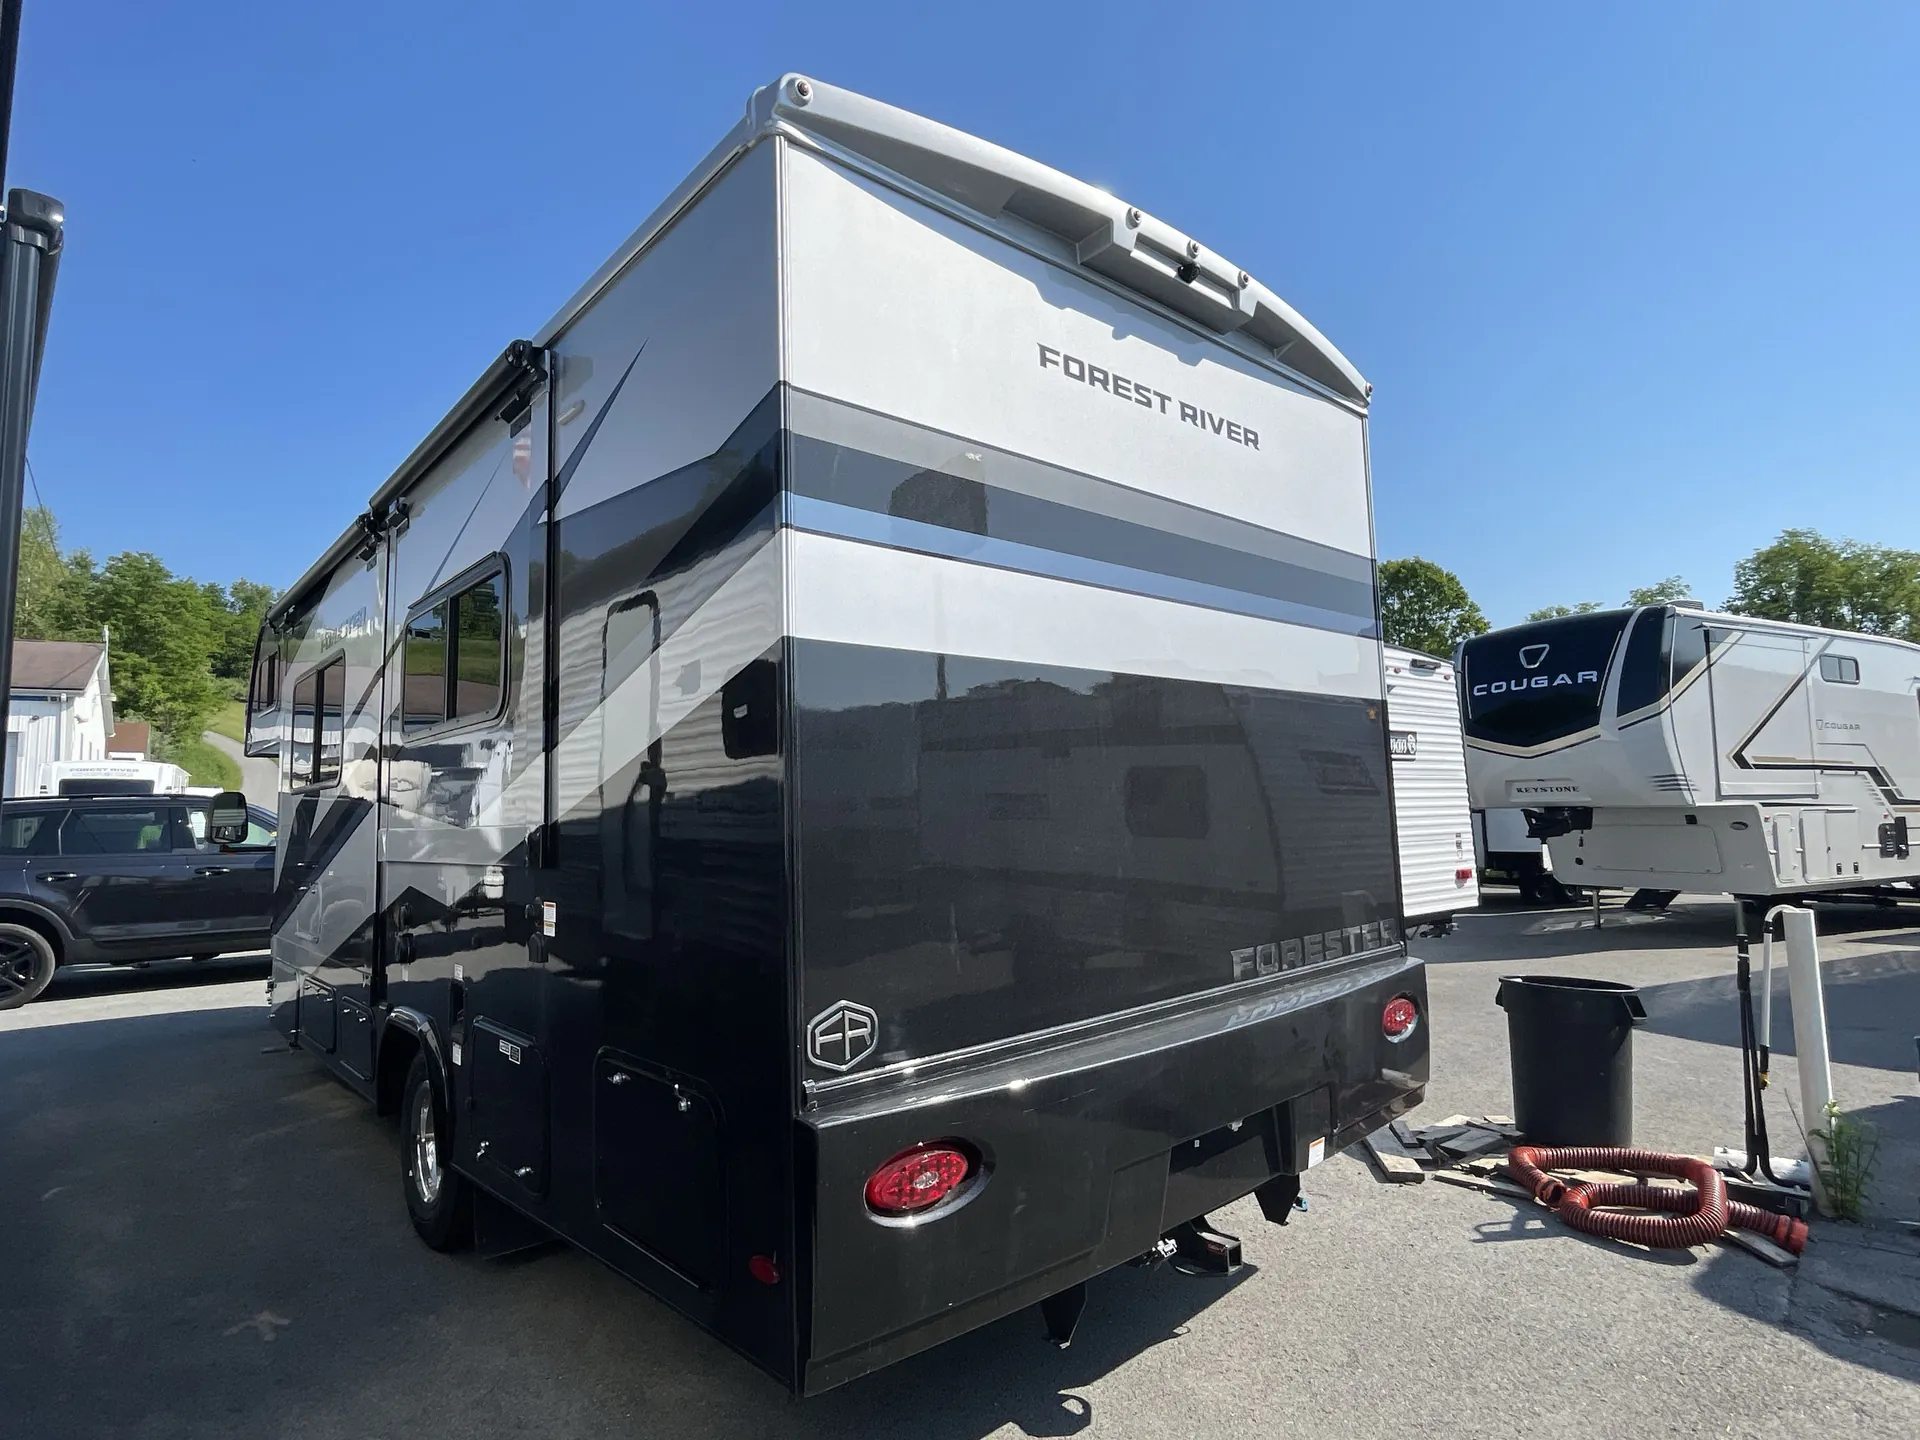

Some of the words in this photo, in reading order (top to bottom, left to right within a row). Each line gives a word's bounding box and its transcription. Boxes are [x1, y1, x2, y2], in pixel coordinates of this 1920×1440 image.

[1036, 341, 1172, 415] FOREST
[1178, 399, 1260, 451] RIVER
[1472, 670, 1598, 697] COUGAR
[1824, 721, 1861, 730] COUGAR
[1516, 785, 1580, 793] KEYSTONE
[1230, 917, 1397, 982] FORESTER
